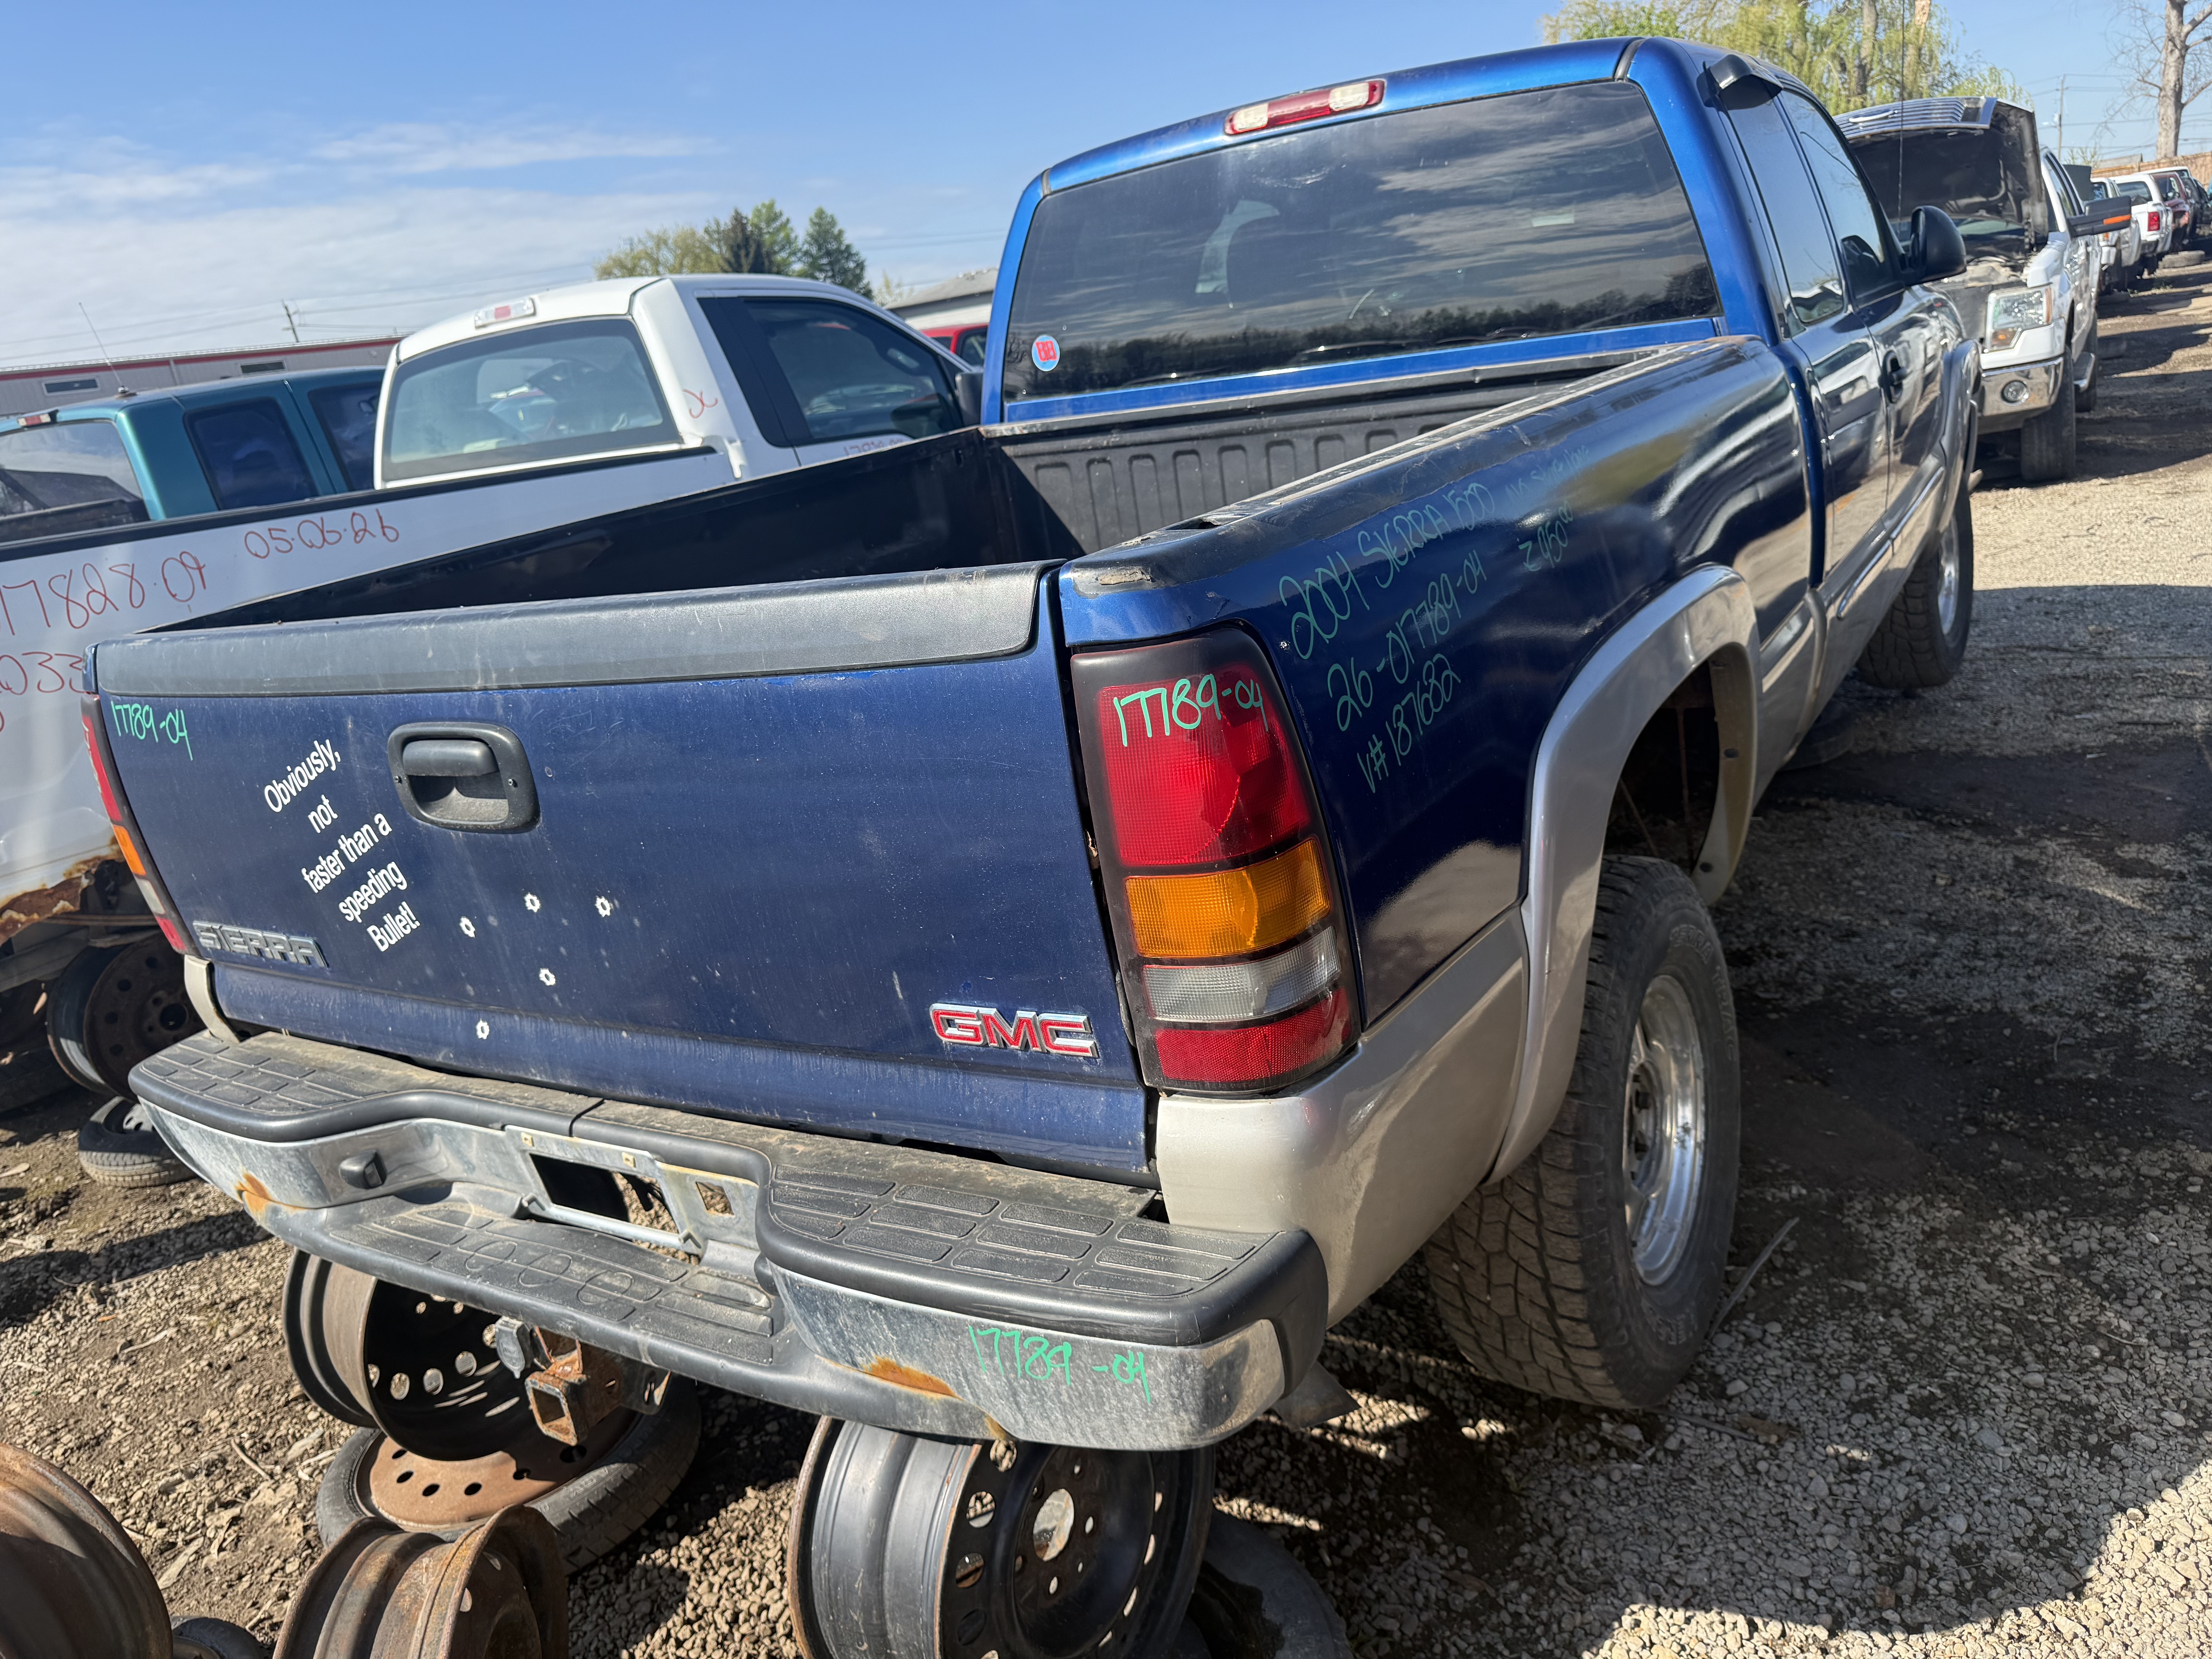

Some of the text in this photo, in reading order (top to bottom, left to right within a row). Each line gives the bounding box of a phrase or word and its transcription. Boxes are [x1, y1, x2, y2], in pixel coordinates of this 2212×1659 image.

[1035, 340, 1058, 362] 88
[1279, 551, 1370, 659] 2004
[1358, 504, 1451, 588] SIERRA
[111, 700, 193, 761] 17789-04
[264, 739, 341, 812] Obviously,
[308, 794, 338, 833] not
[301, 813, 393, 893] faster than a
[338, 861, 408, 923] speeding
[193, 921, 330, 968] SIERRA
[366, 901, 421, 952] Bullet!
[929, 1003, 1099, 1059] GMC
